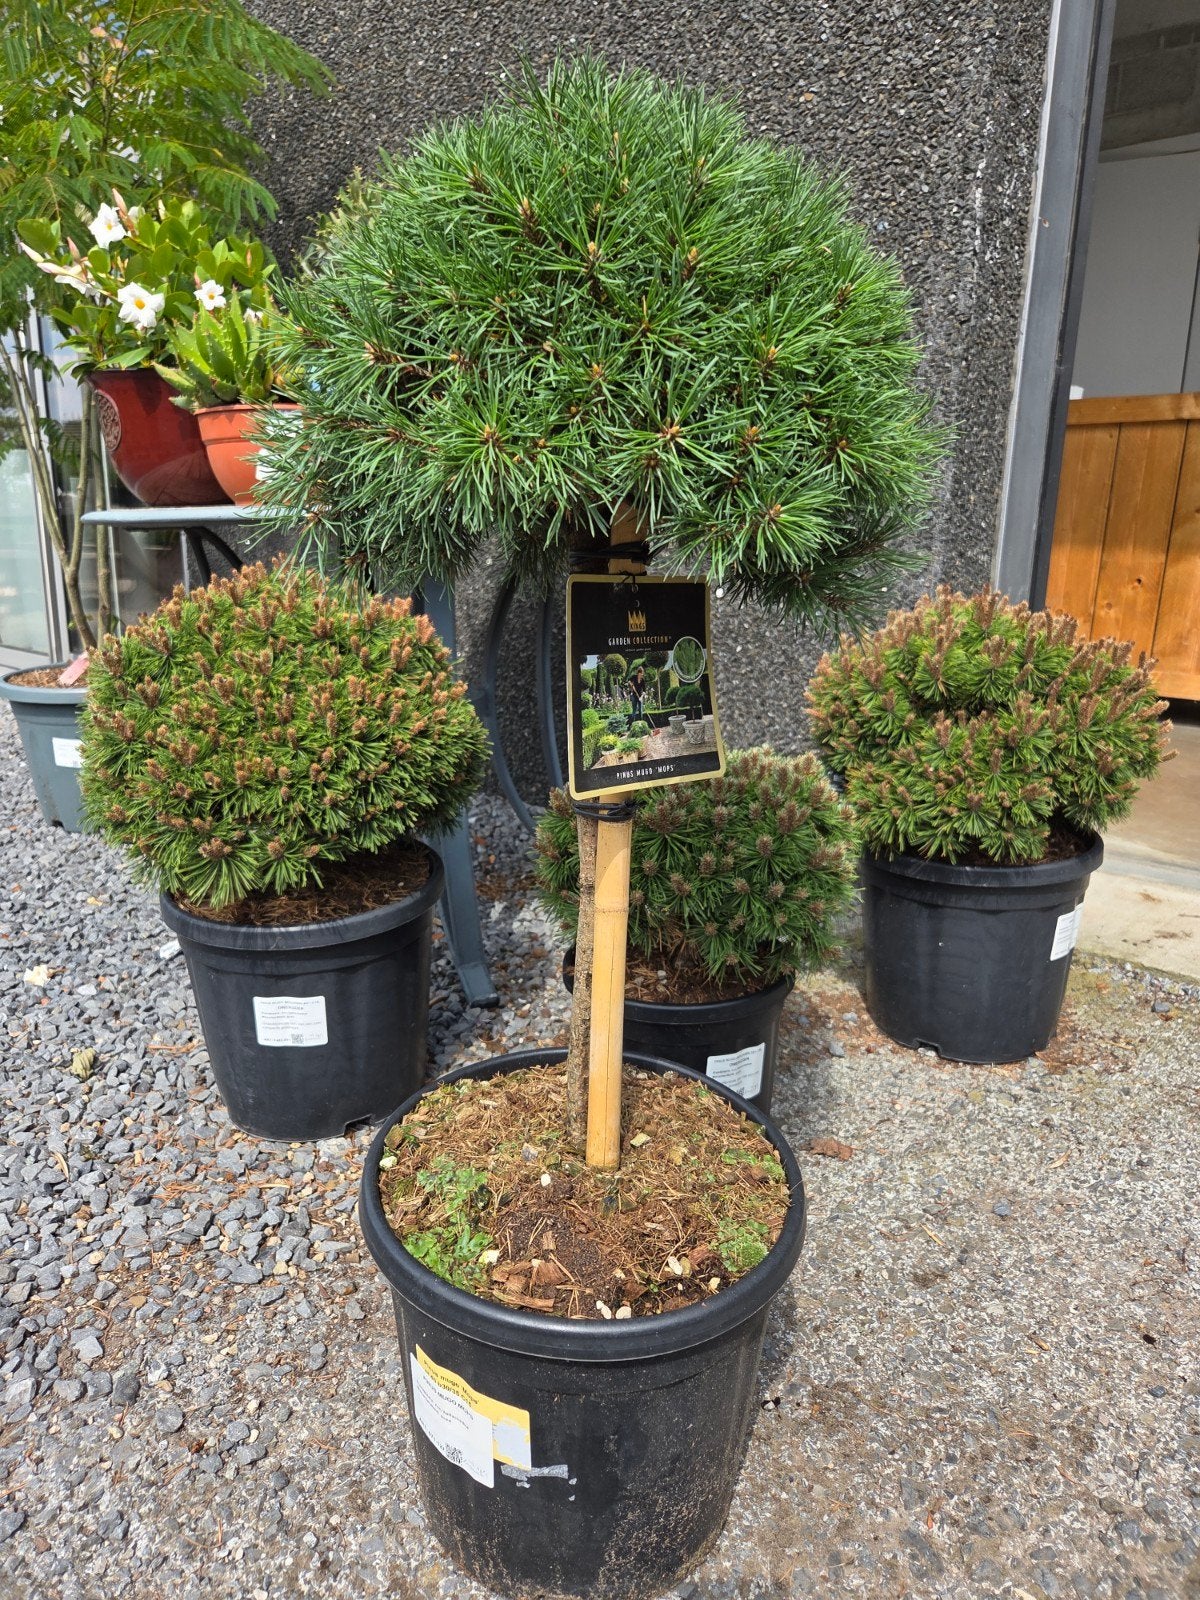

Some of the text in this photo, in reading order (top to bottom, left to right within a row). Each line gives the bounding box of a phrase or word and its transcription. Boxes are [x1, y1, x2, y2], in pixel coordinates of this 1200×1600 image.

[608, 637, 631, 646] GARDEN
[616, 770, 634, 780] PINUS
[636, 767, 653, 777] MUGO
